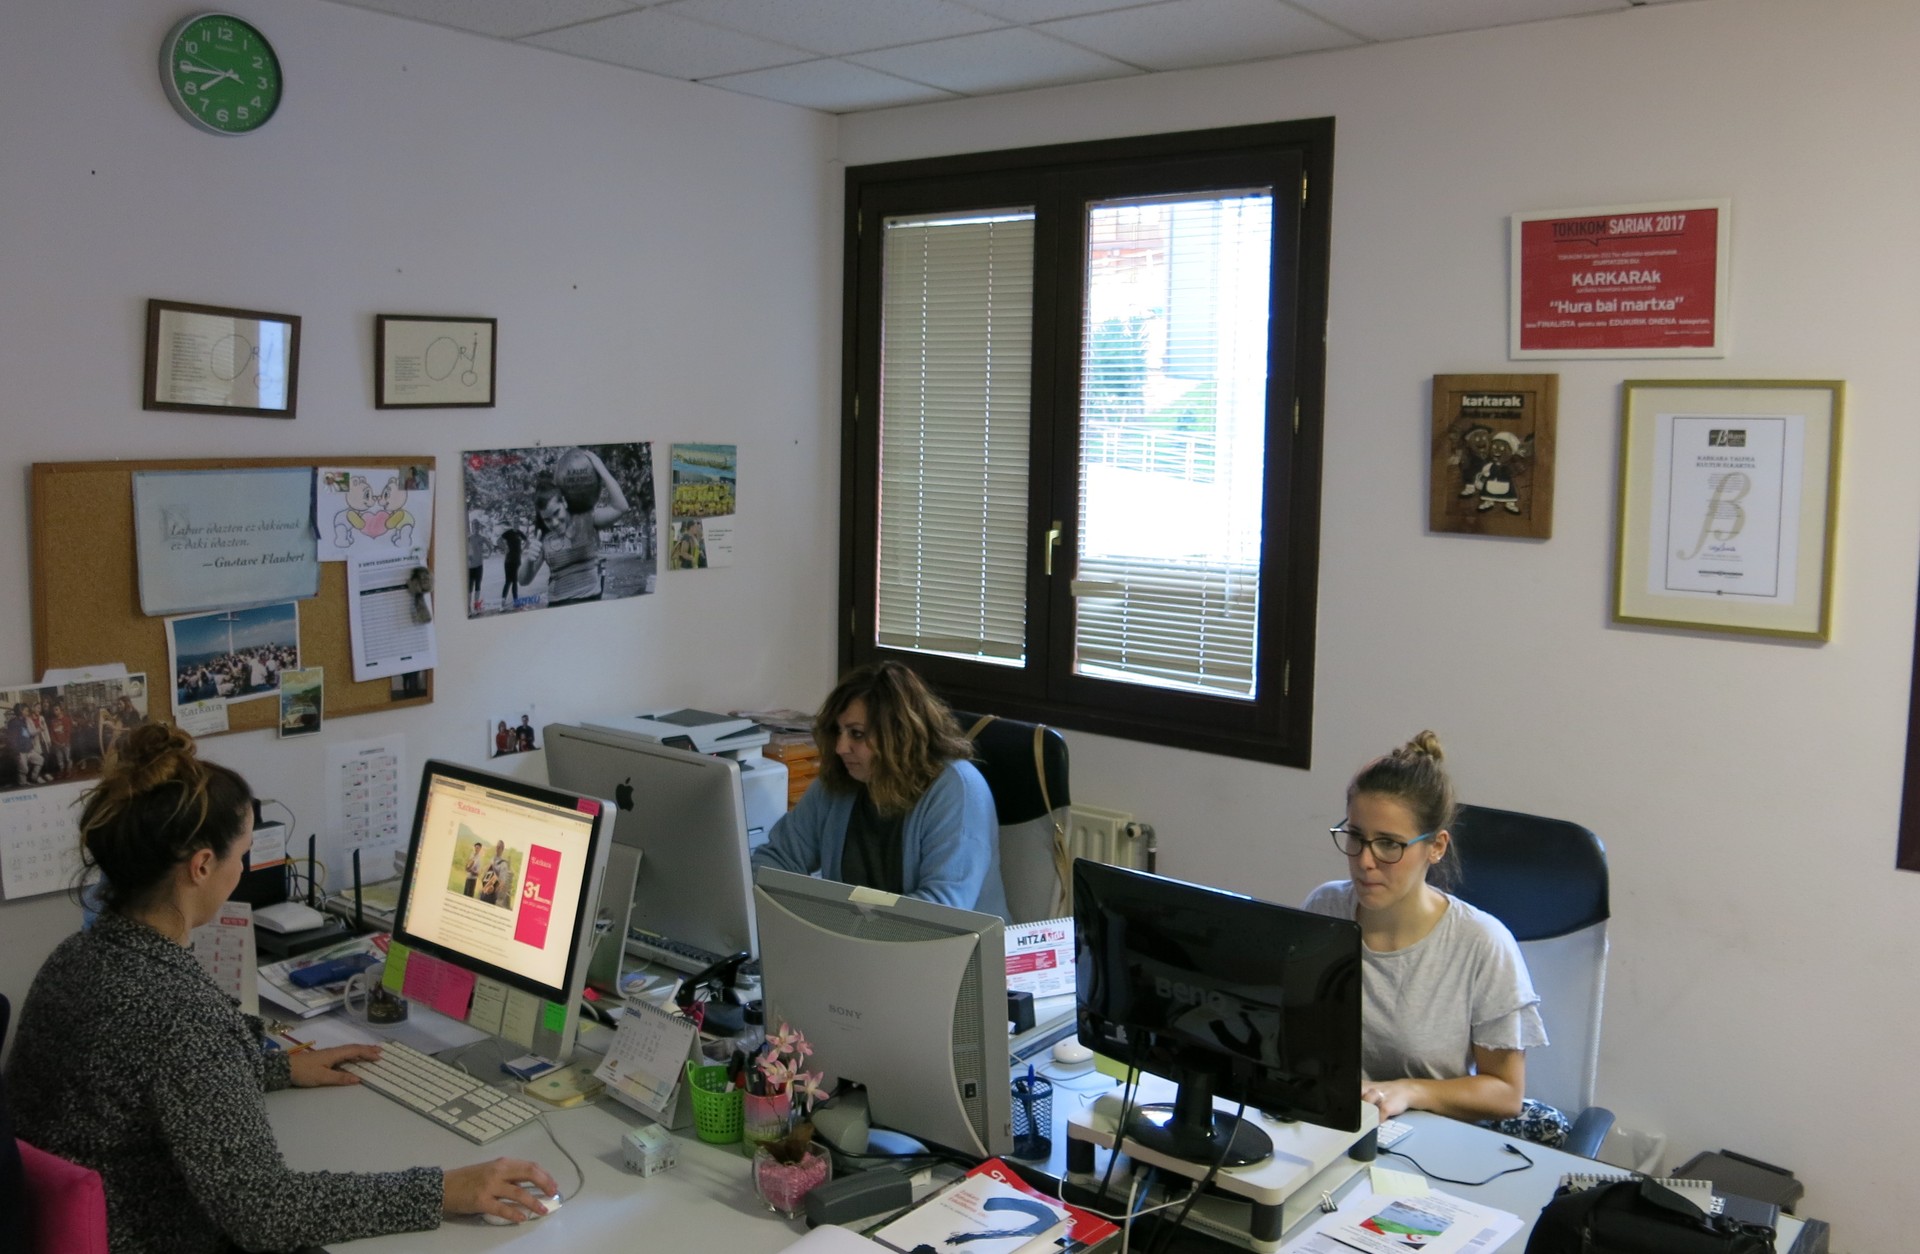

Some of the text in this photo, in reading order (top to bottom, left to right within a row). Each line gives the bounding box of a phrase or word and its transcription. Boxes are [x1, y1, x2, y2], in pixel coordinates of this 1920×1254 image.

[202, 29, 211, 42] 11
[218, 26, 233, 41] 12
[185, 41, 198, 54] 10
[252, 56, 263, 69] 2
[184, 81, 197, 95] 8
[257, 76, 268, 90] 3
[200, 98, 209, 112] 7
[251, 96, 262, 108] 4
[216, 109, 229, 122] 6
[237, 106, 249, 119] 5
[1552, 215, 1686, 238] TOKIKOM SARIAK 2017
[1572, 270, 1661, 287] KARKARAk
[1596, 299, 1617, 313] bai
[1462, 395, 1521, 407] karkarak
[261, 551, 305, 565] Flaubert
[829, 1004, 862, 1019] SONY
